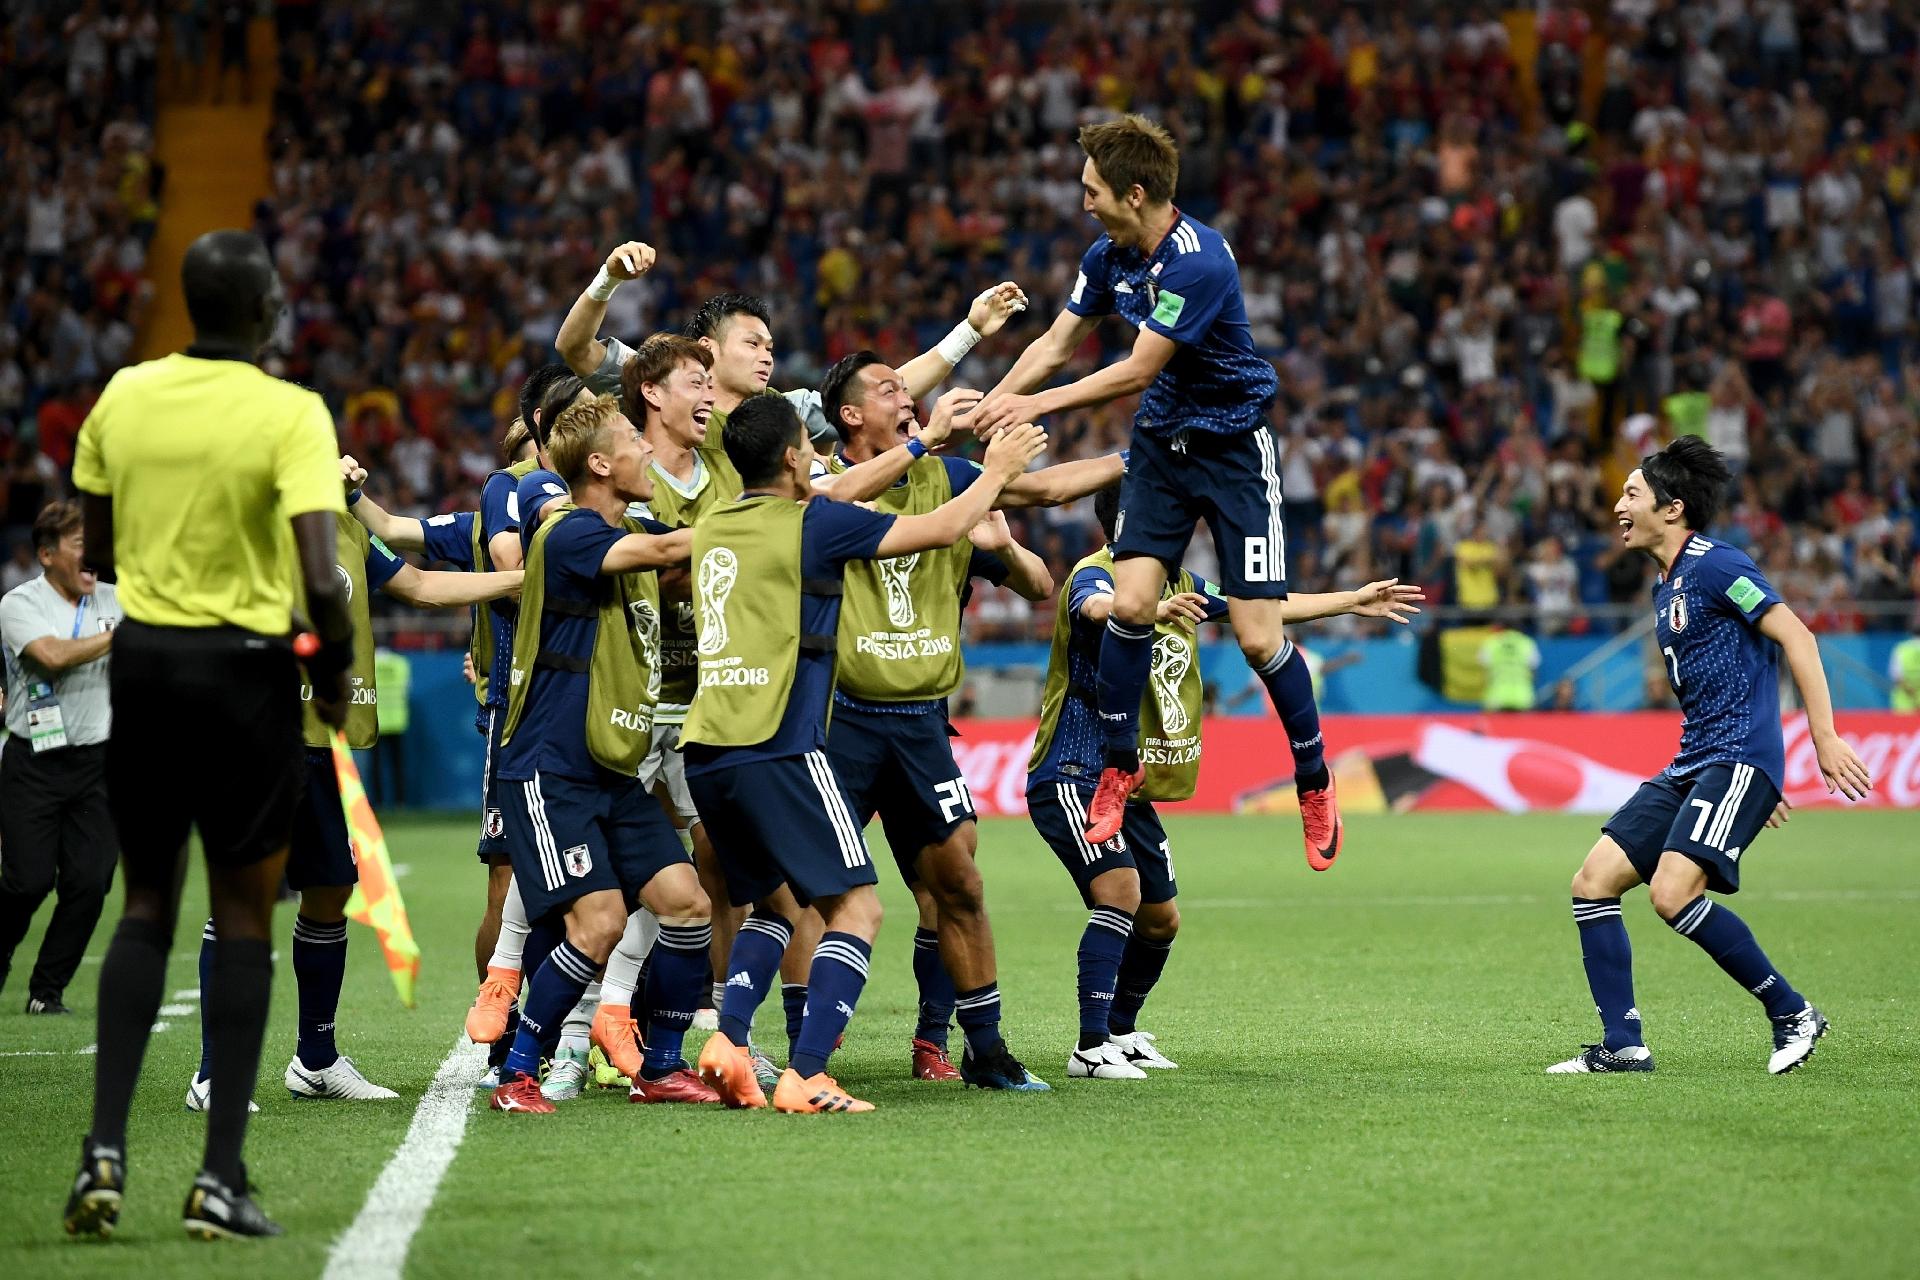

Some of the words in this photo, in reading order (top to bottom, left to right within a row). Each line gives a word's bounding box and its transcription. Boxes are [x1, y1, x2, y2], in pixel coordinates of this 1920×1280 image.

[1244, 536, 1268, 582] 8
[919, 635, 953, 656] 2018
[1663, 645, 1682, 687] 7
[721, 667, 769, 686] 2018
[351, 687, 377, 705] 2018
[1145, 737, 1162, 746] FIFA
[1162, 739, 1188, 748] WORLD
[1187, 735, 1197, 745] CUP
[1137, 748, 1184, 765] USSIA
[1689, 798, 1714, 843] 7
